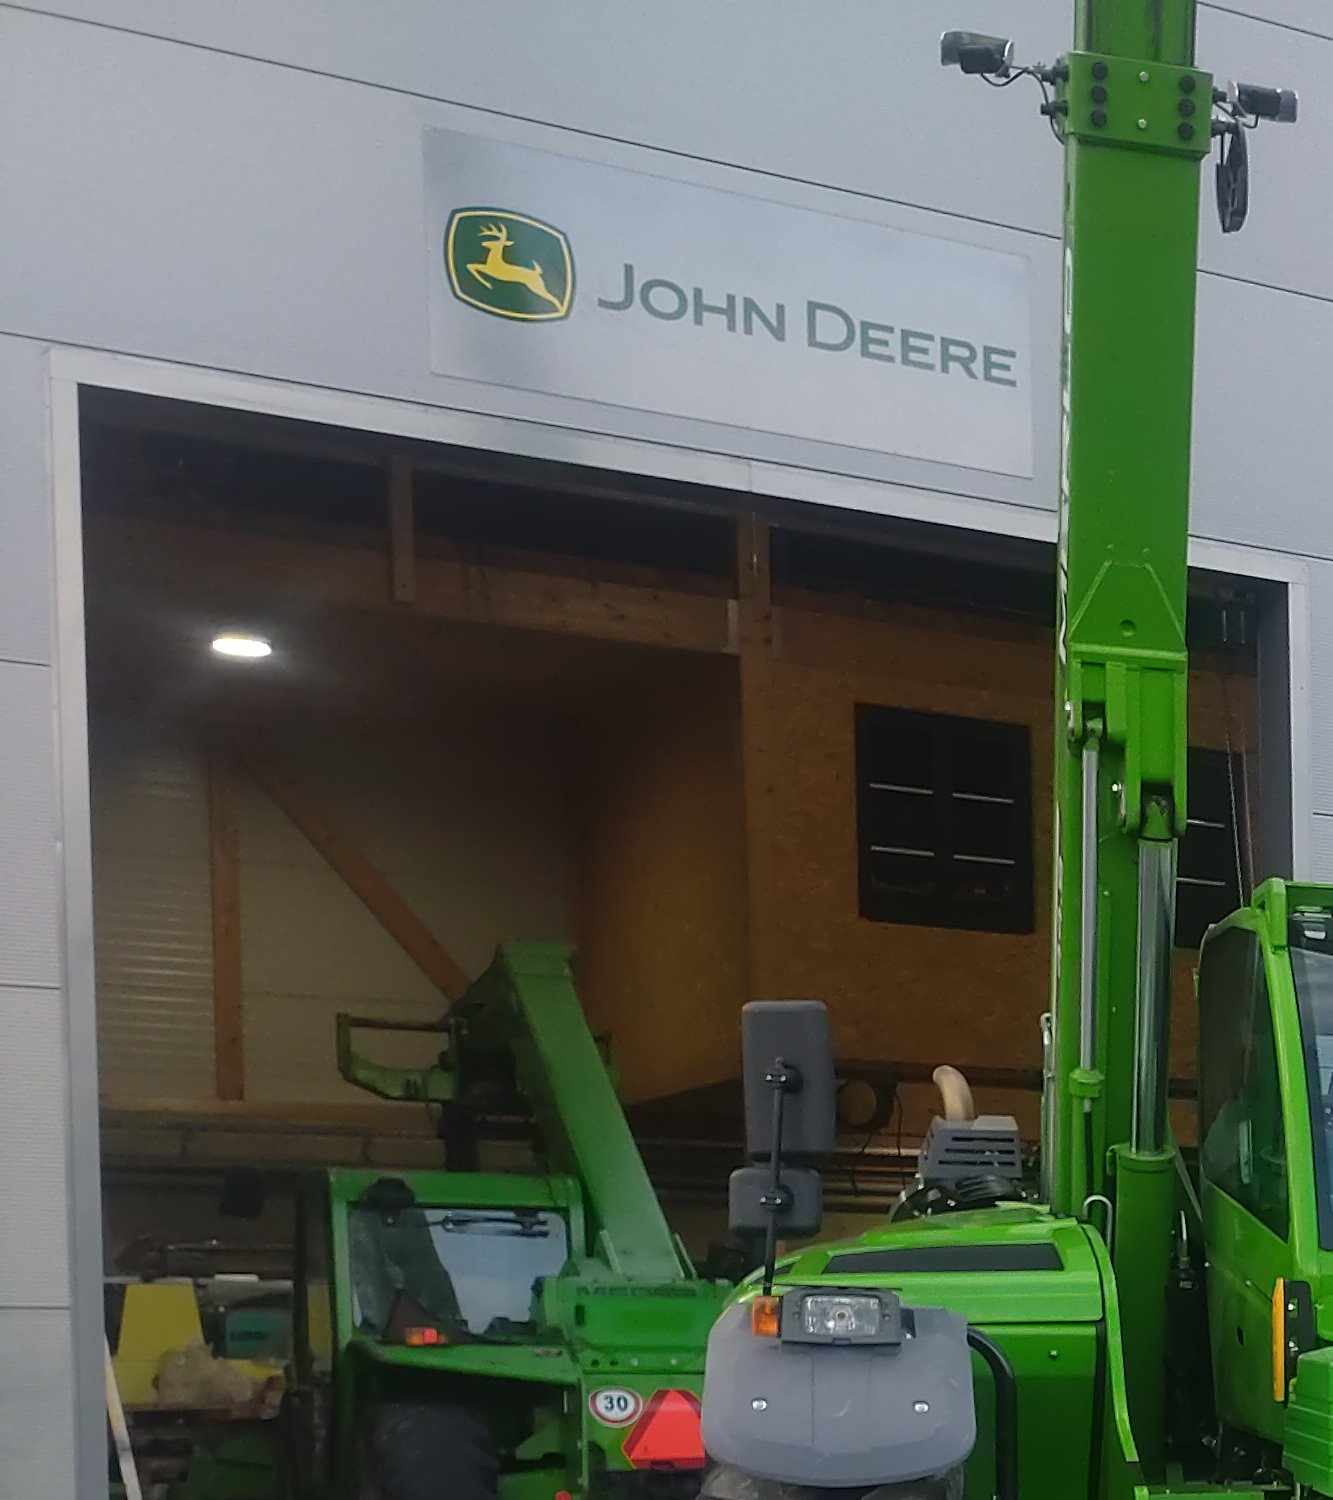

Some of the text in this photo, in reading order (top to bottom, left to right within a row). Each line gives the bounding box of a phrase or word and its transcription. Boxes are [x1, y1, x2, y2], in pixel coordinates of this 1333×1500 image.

[597, 263, 1018, 387] JOHN DEERE
[604, 1395, 628, 1411] 30
